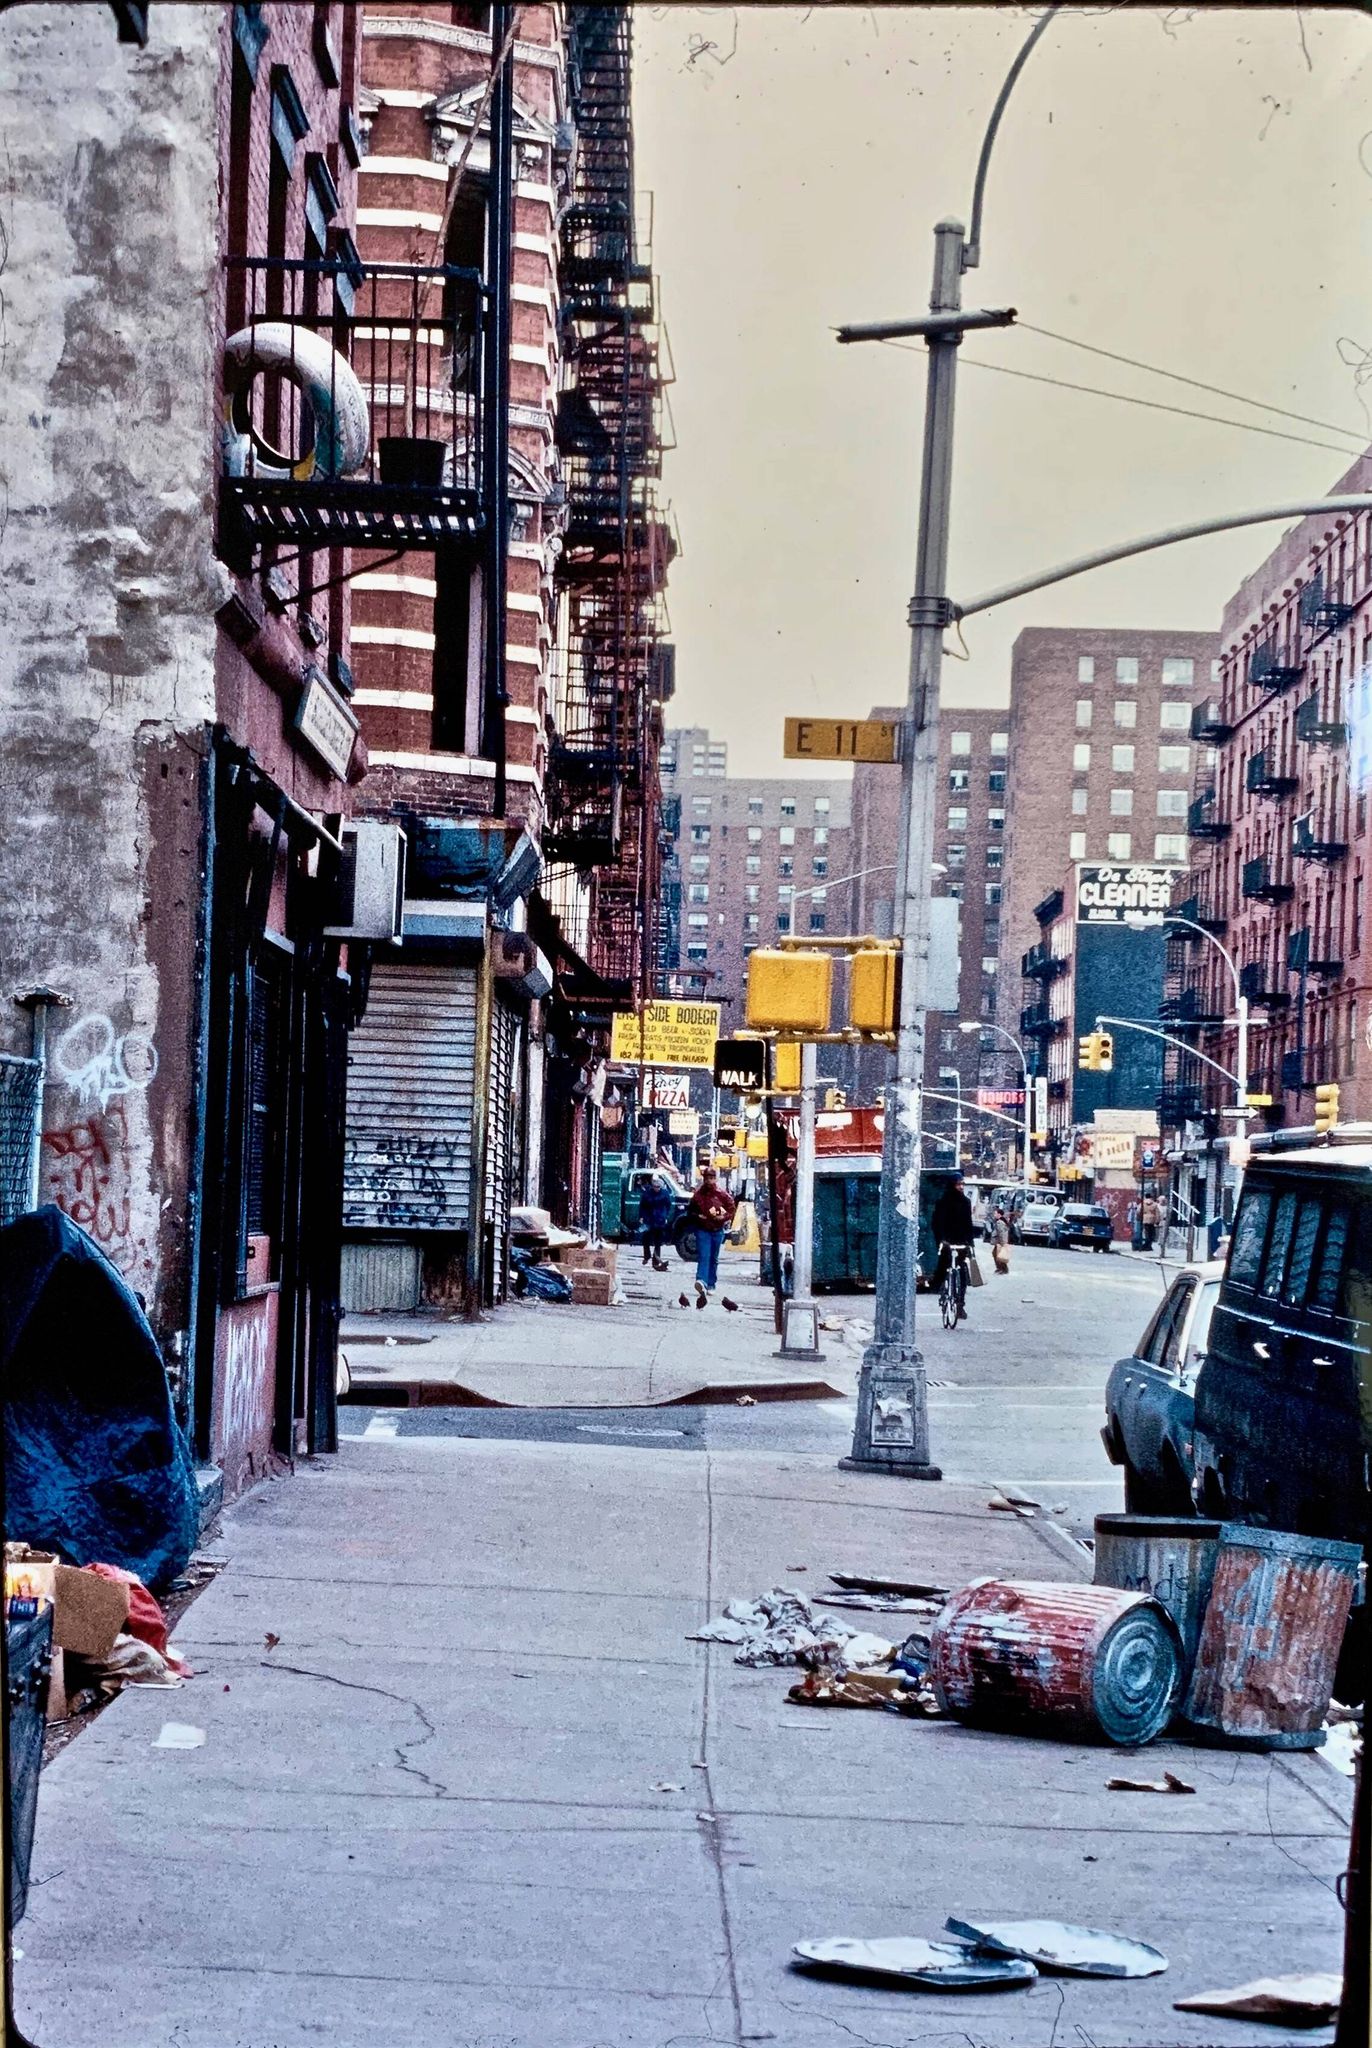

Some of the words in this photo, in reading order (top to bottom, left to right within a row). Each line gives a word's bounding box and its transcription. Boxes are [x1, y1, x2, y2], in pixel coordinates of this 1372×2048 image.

[797, 723, 812, 752] E
[835, 725, 857, 755] 11
[648, 1005, 671, 1022] SIDE
[676, 1007, 718, 1026] BODEGA
[720, 1070, 758, 1086] WALK
[648, 1089, 688, 1107] PIZZA
